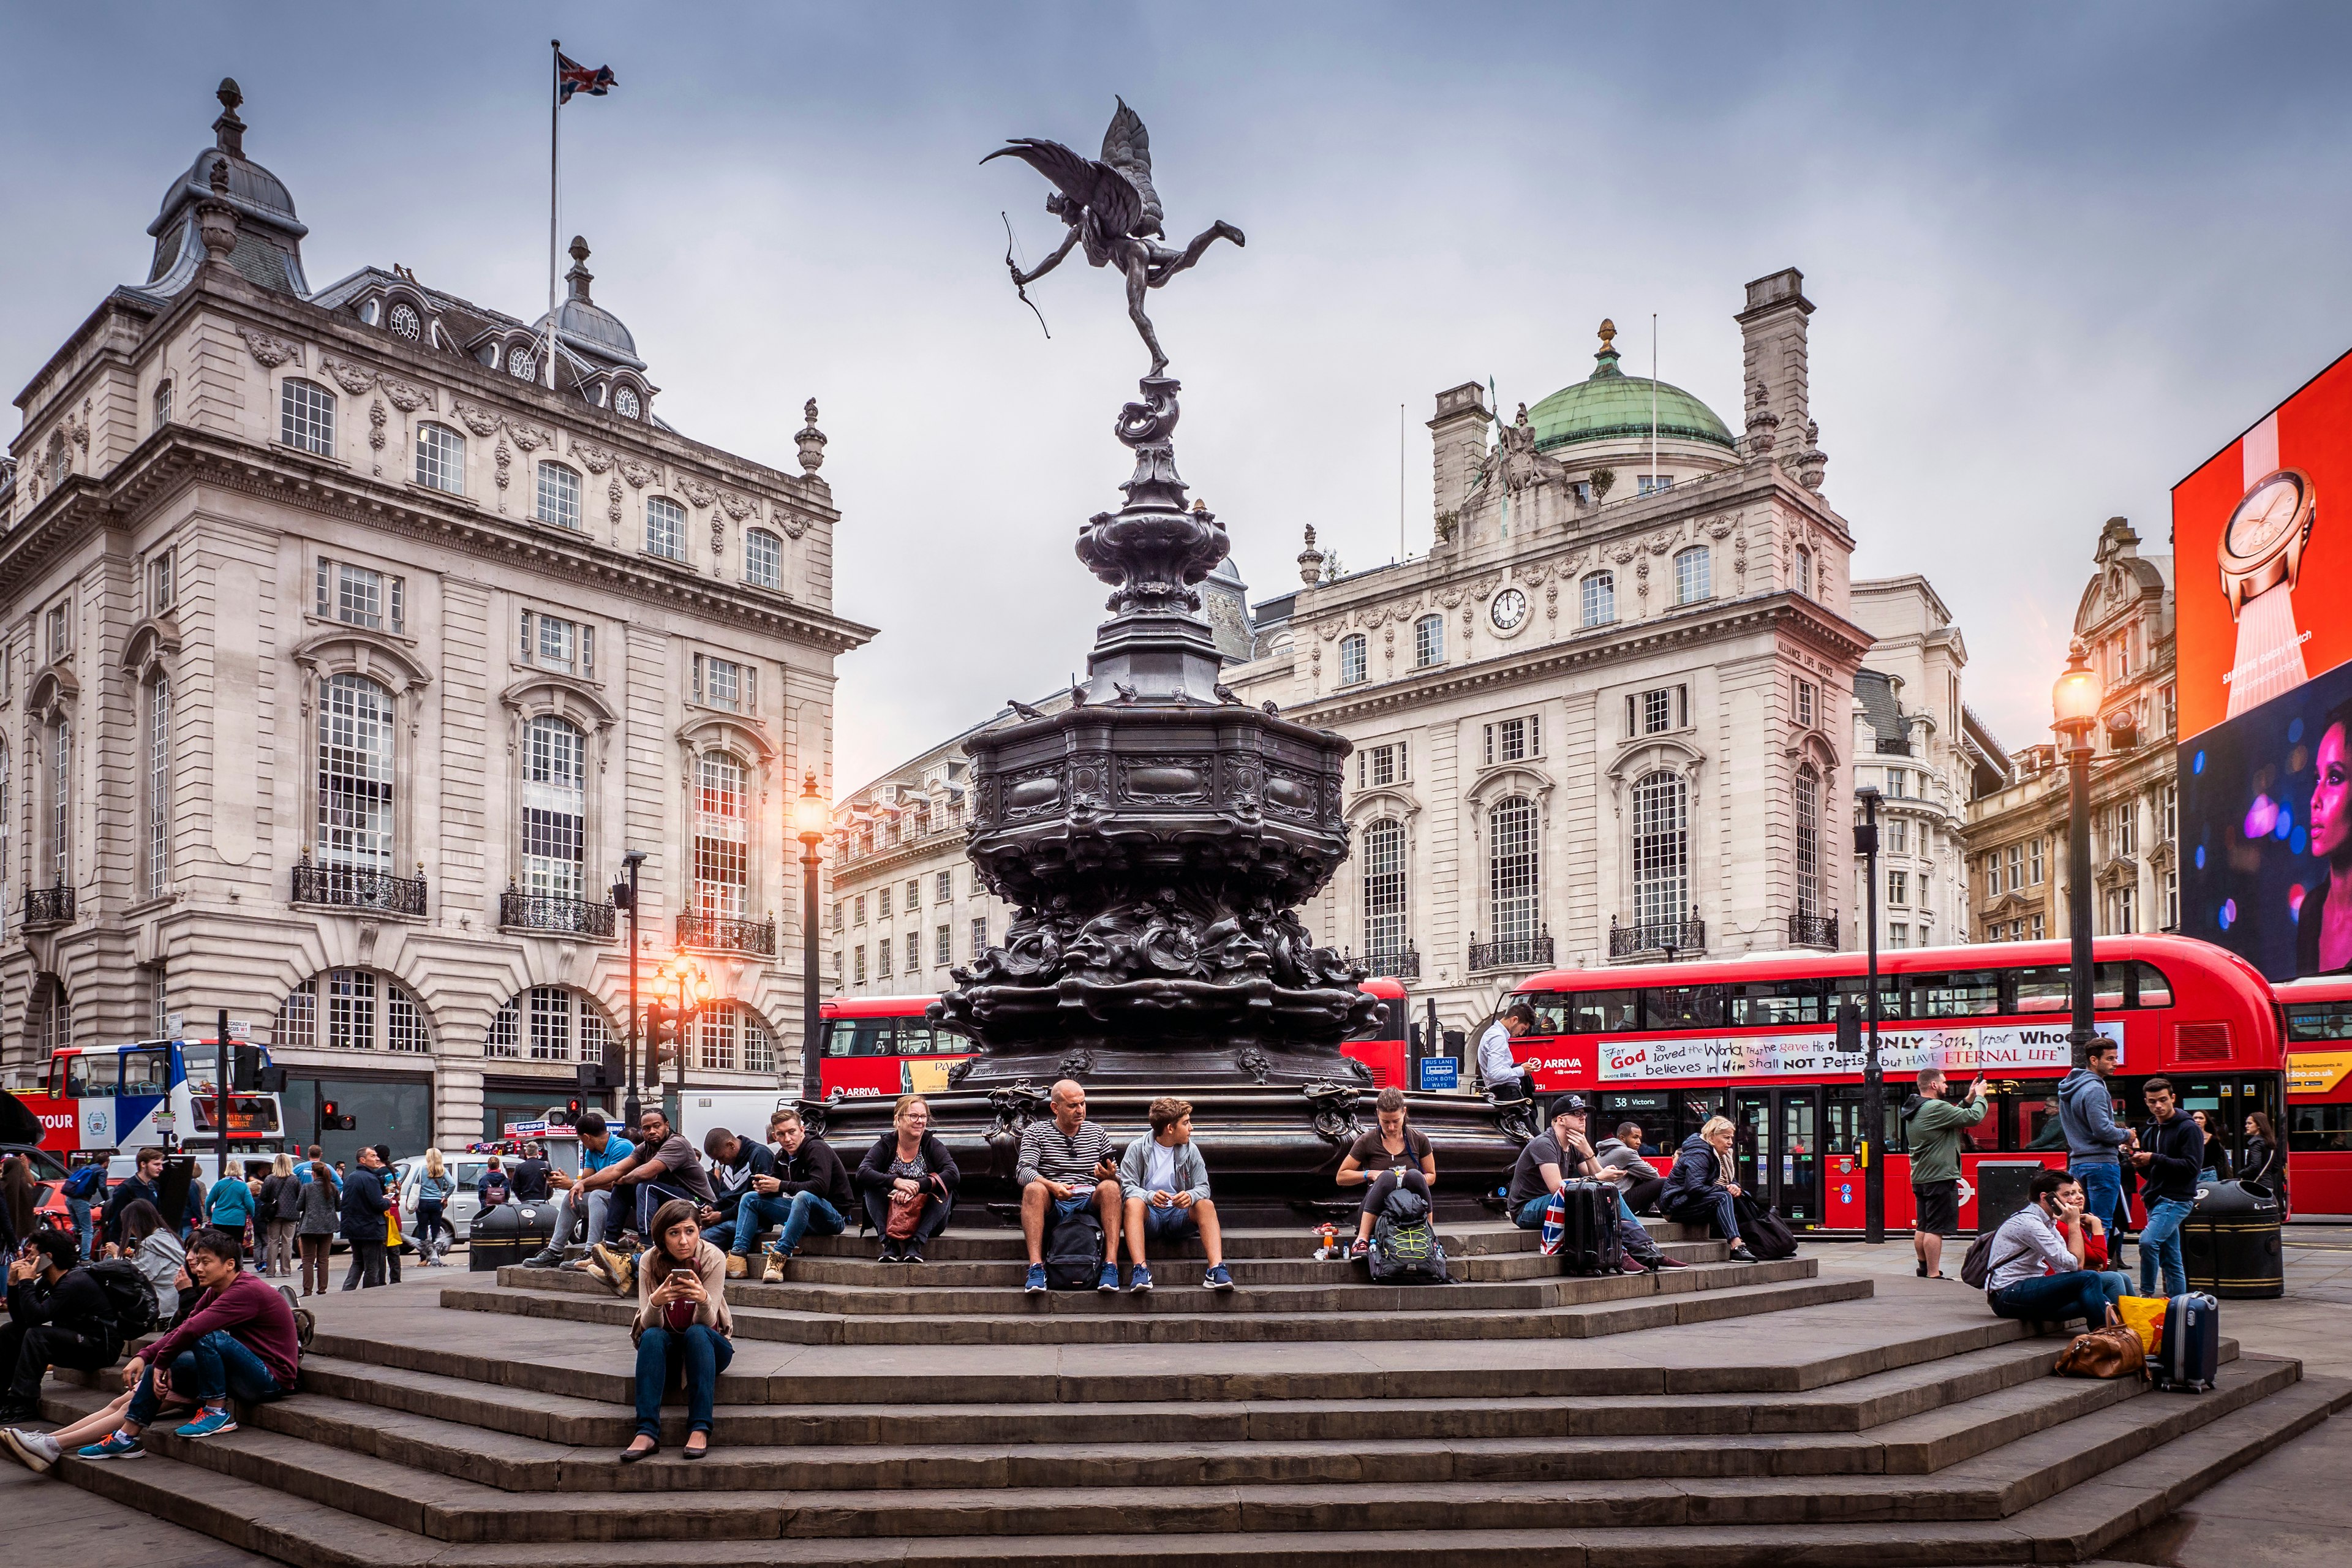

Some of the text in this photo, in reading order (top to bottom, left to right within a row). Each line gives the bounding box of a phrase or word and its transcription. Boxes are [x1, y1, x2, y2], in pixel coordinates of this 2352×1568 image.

[1777, 641, 1833, 677] ALLIANCE LIFE OFFICE
[2223, 630, 2312, 684] SAMSUNG Galaxy Watch
[2231, 657, 2301, 698] Stay connected longer
[1450, 976, 1494, 987] COUNTY
[1929, 1032, 1973, 1050] Son,
[1981, 1033, 2013, 1046] that
[1602, 1047, 1626, 1059] For
[1704, 1042, 1744, 1057] World,
[1746, 1046, 1763, 1056] THAT
[1763, 1042, 1777, 1053] he
[1779, 1042, 1809, 1054] gave
[1813, 1041, 1825, 1052] His
[1611, 1049, 1646, 1070] God
[1654, 1047, 1686, 1062] loved
[1544, 1058, 1581, 1068] ARRIVA
[1646, 1063, 1701, 1075] believes
[1707, 1065, 1716, 1074] in
[1722, 1059, 1745, 1072] Him
[1749, 1058, 1779, 1069] shall
[1784, 1058, 1815, 1069] NOT
[1881, 1057, 1902, 1068] but
[1906, 1053, 1939, 1065] HAVE
[1945, 1049, 2021, 1064] ETERNAL
[846, 1087, 881, 1096] ARRIVA
[1615, 1098, 1627, 1107] 38
[37, 1114, 73, 1128] TOUR
